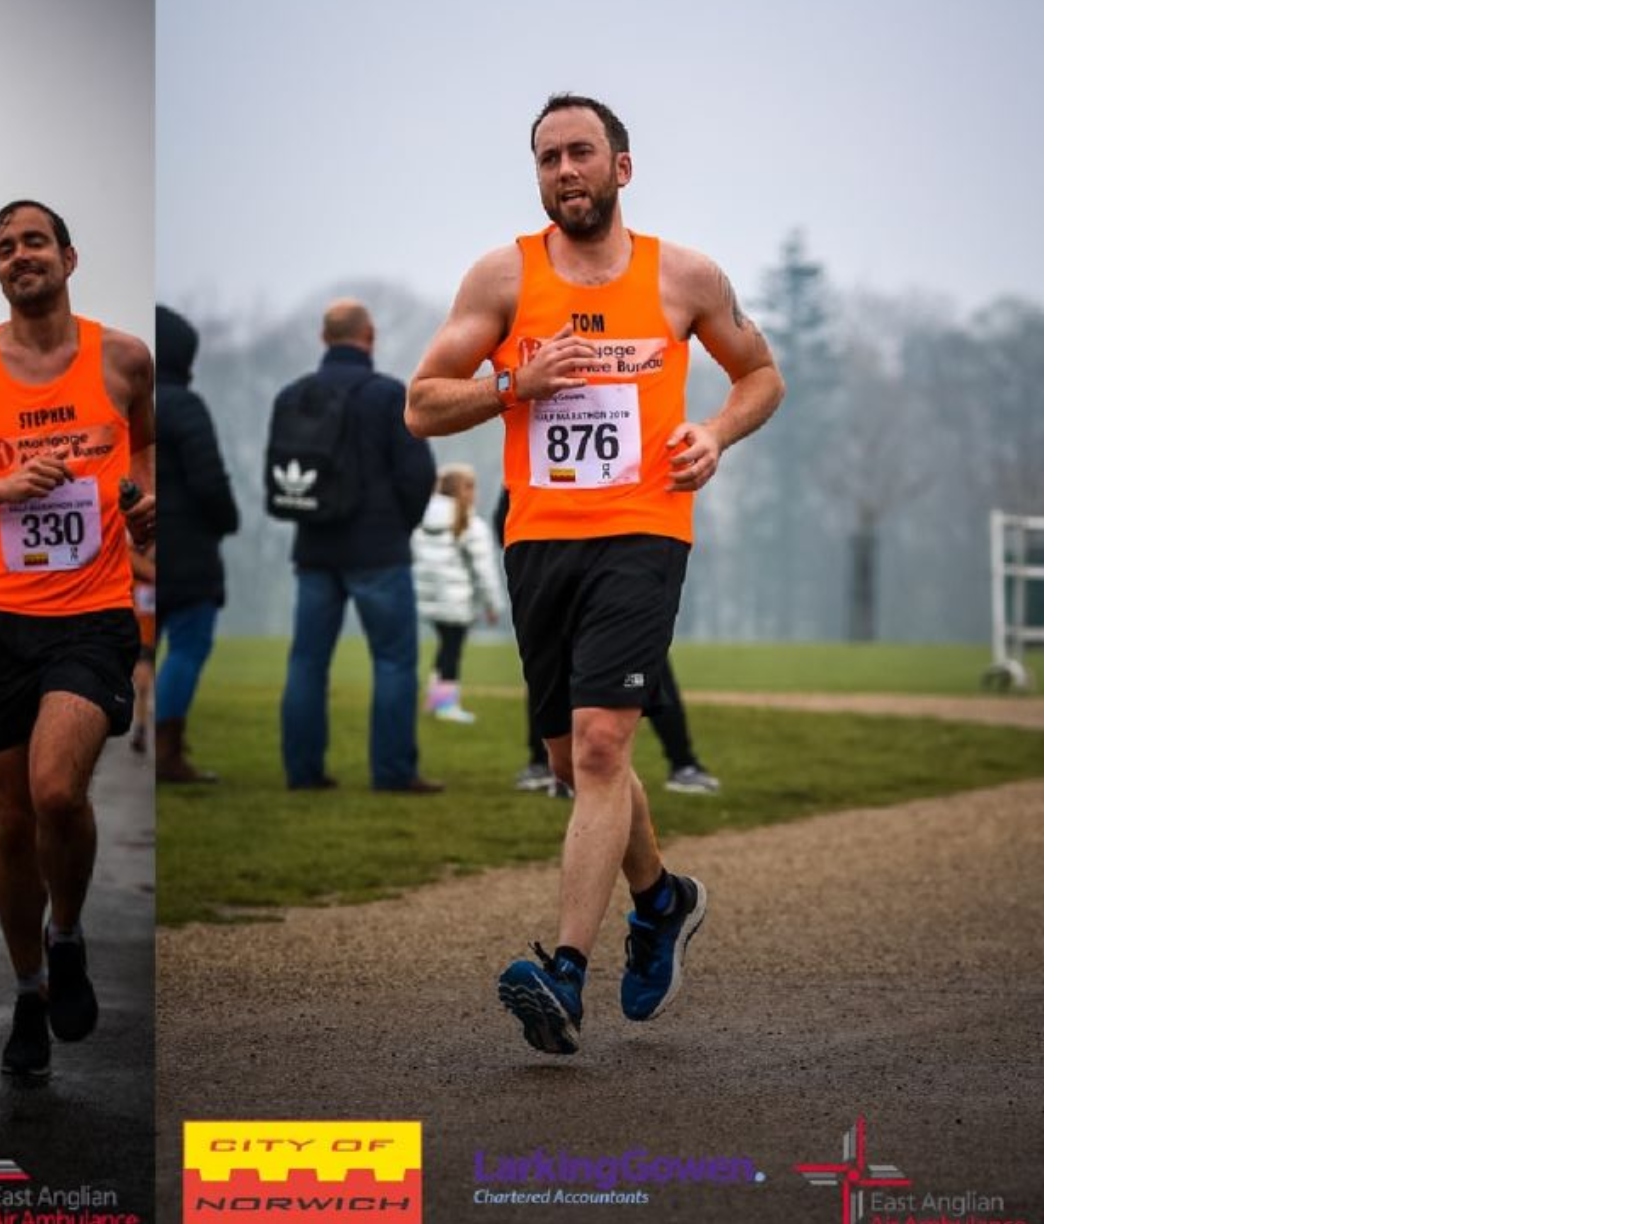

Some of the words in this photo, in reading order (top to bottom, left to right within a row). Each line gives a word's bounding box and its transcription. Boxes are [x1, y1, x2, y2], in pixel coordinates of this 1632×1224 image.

[571, 312, 606, 333] TOM
[19, 406, 77, 429] STEPHEN
[546, 423, 620, 463] 876
[21, 510, 84, 548] 330
